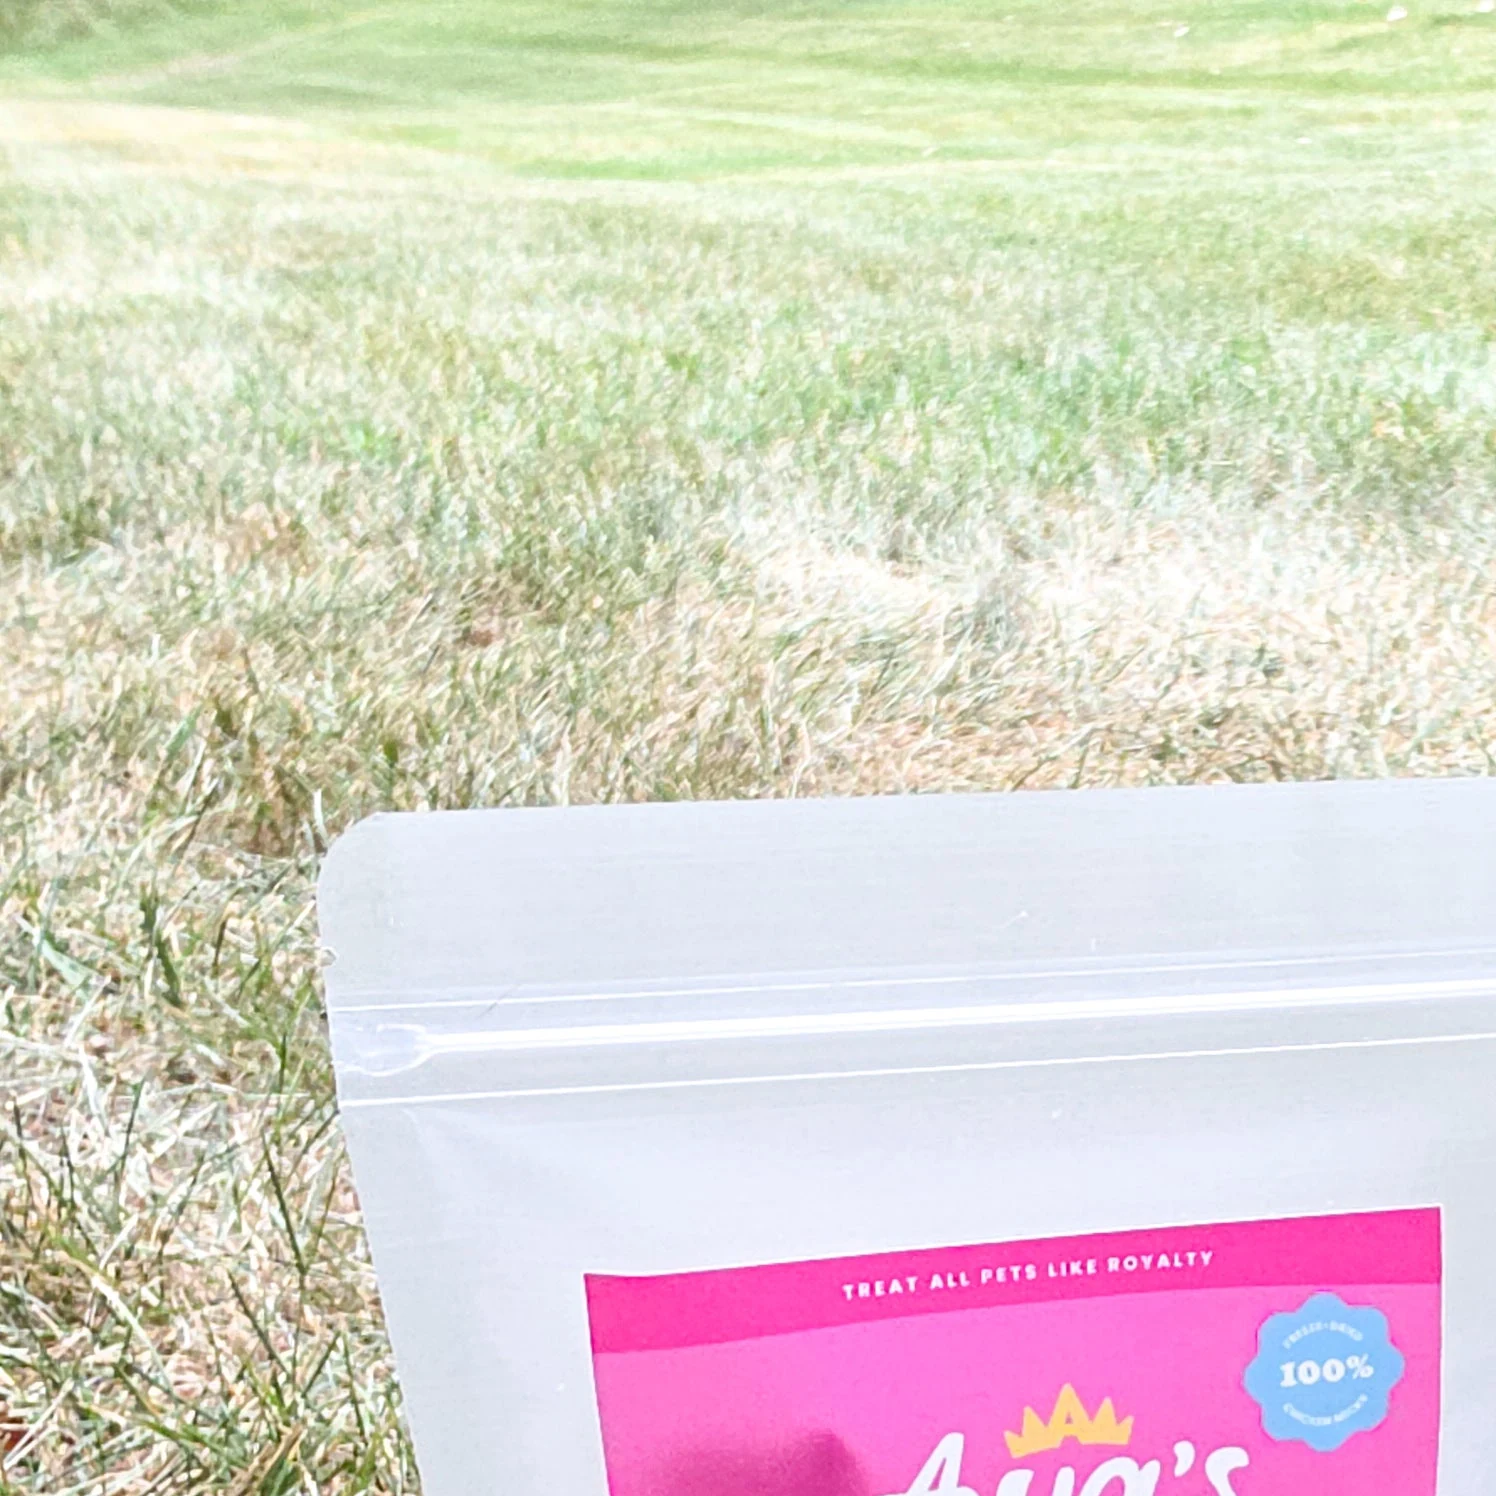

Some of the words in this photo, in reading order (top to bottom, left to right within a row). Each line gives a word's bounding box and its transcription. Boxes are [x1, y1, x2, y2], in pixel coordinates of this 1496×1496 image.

[842, 1276, 919, 1300] TREAT
[930, 1273, 971, 1290] ALL
[980, 1265, 1037, 1286] PETS
[1047, 1258, 1098, 1279] LIKE
[1106, 1251, 1214, 1273] ROYALTY
[1279, 1353, 1375, 1388] 100%
